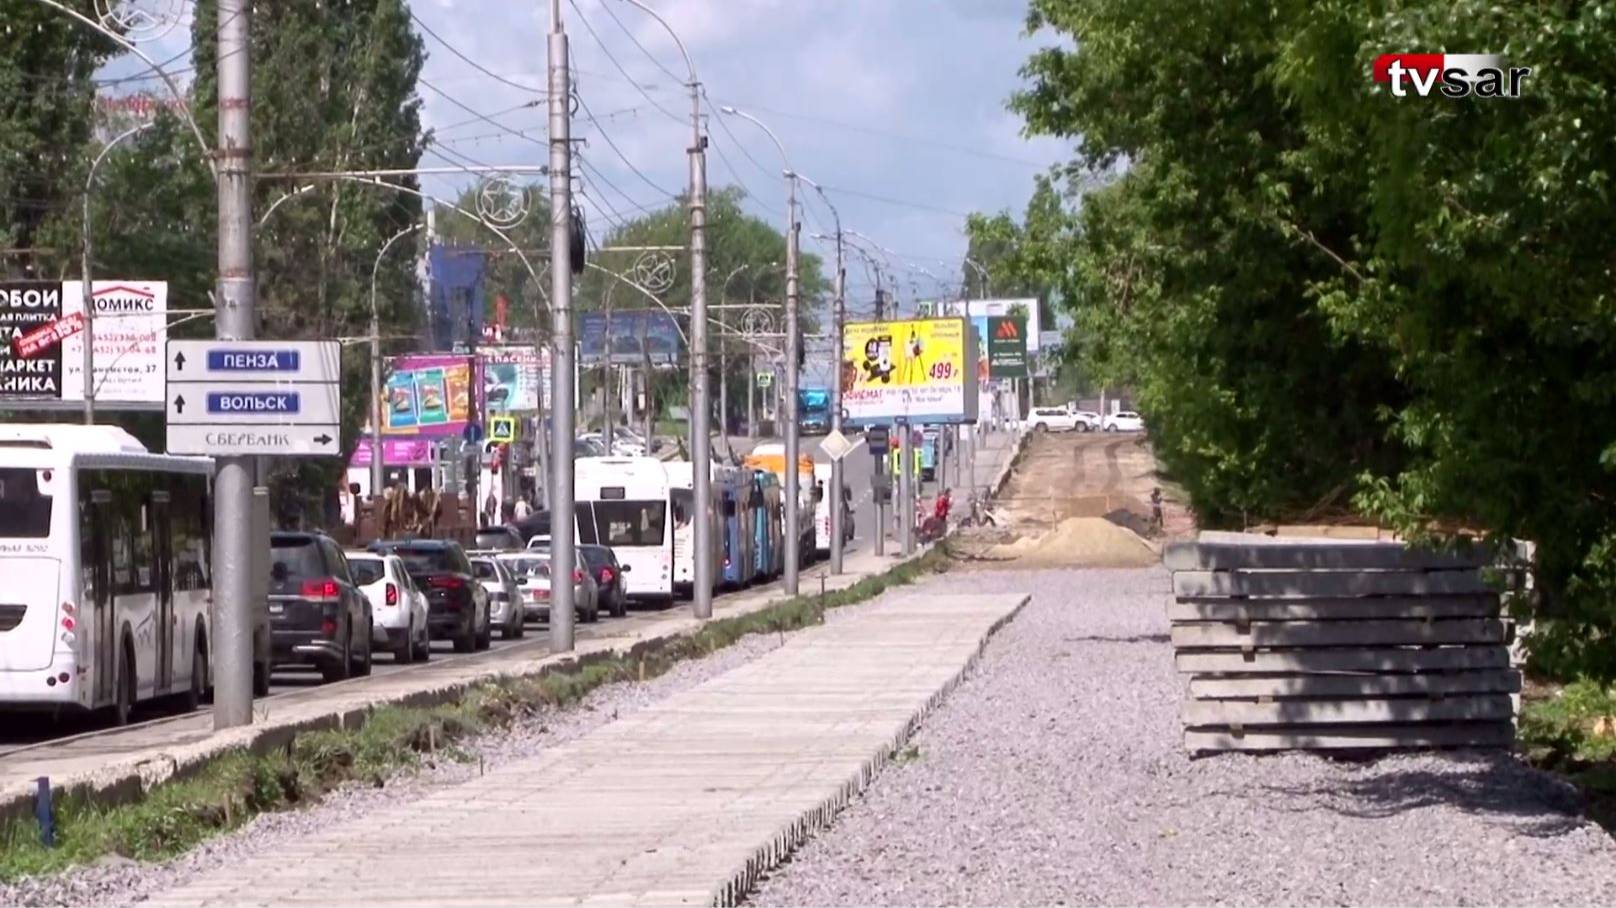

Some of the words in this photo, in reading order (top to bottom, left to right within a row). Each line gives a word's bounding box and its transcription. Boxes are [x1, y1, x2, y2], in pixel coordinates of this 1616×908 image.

[93, 298, 154, 311] ОМИКС
[0, 359, 56, 372] АРКЕТ
[223, 354, 279, 368] ПЕНЗА
[929, 362, 952, 379] 499
[0, 376, 56, 391] НИКА
[220, 396, 287, 410] ВОЛЬСК
[205, 433, 290, 446] СБЕРБАНК
